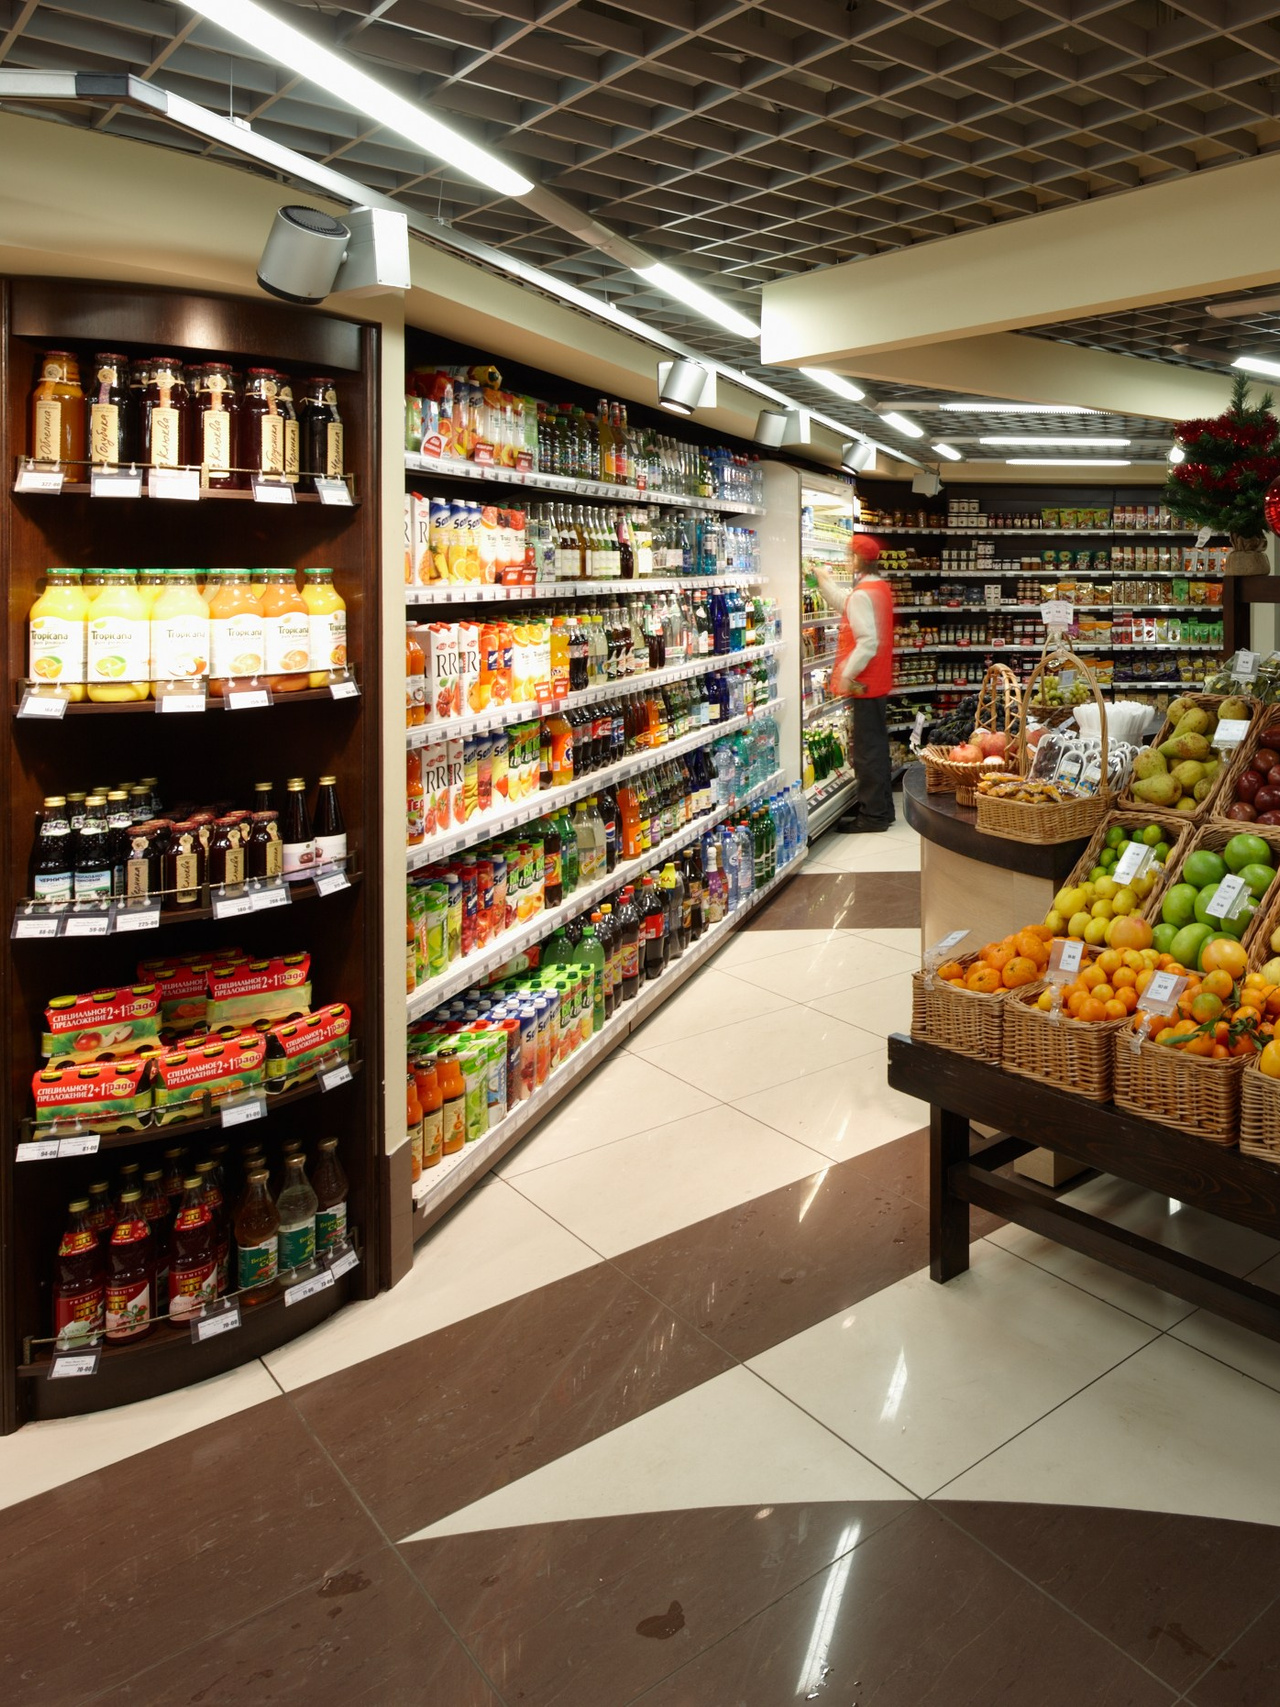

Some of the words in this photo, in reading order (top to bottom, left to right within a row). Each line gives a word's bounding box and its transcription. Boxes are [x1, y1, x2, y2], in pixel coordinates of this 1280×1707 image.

[31, 630, 69, 641] Tropicana
[91, 630, 133, 641] Tropicana
[52, 1007, 107, 1023] СПЕЦИАЛЬНОЕ
[52, 1014, 107, 1029] ПРЕДЛОЖЕНИЕ
[167, 1061, 217, 1079] СПЕЦИАЛЬНОЕ
[167, 1068, 217, 1085] ПРЕДЛОЖЕНИЕ
[37, 1084, 88, 1096] СПЕЦИАЛЬНОЕ
[36, 1091, 88, 1102] ПРЕДЛОЖЕНИЕ
[176, 1268, 209, 1280] PREMIUM
